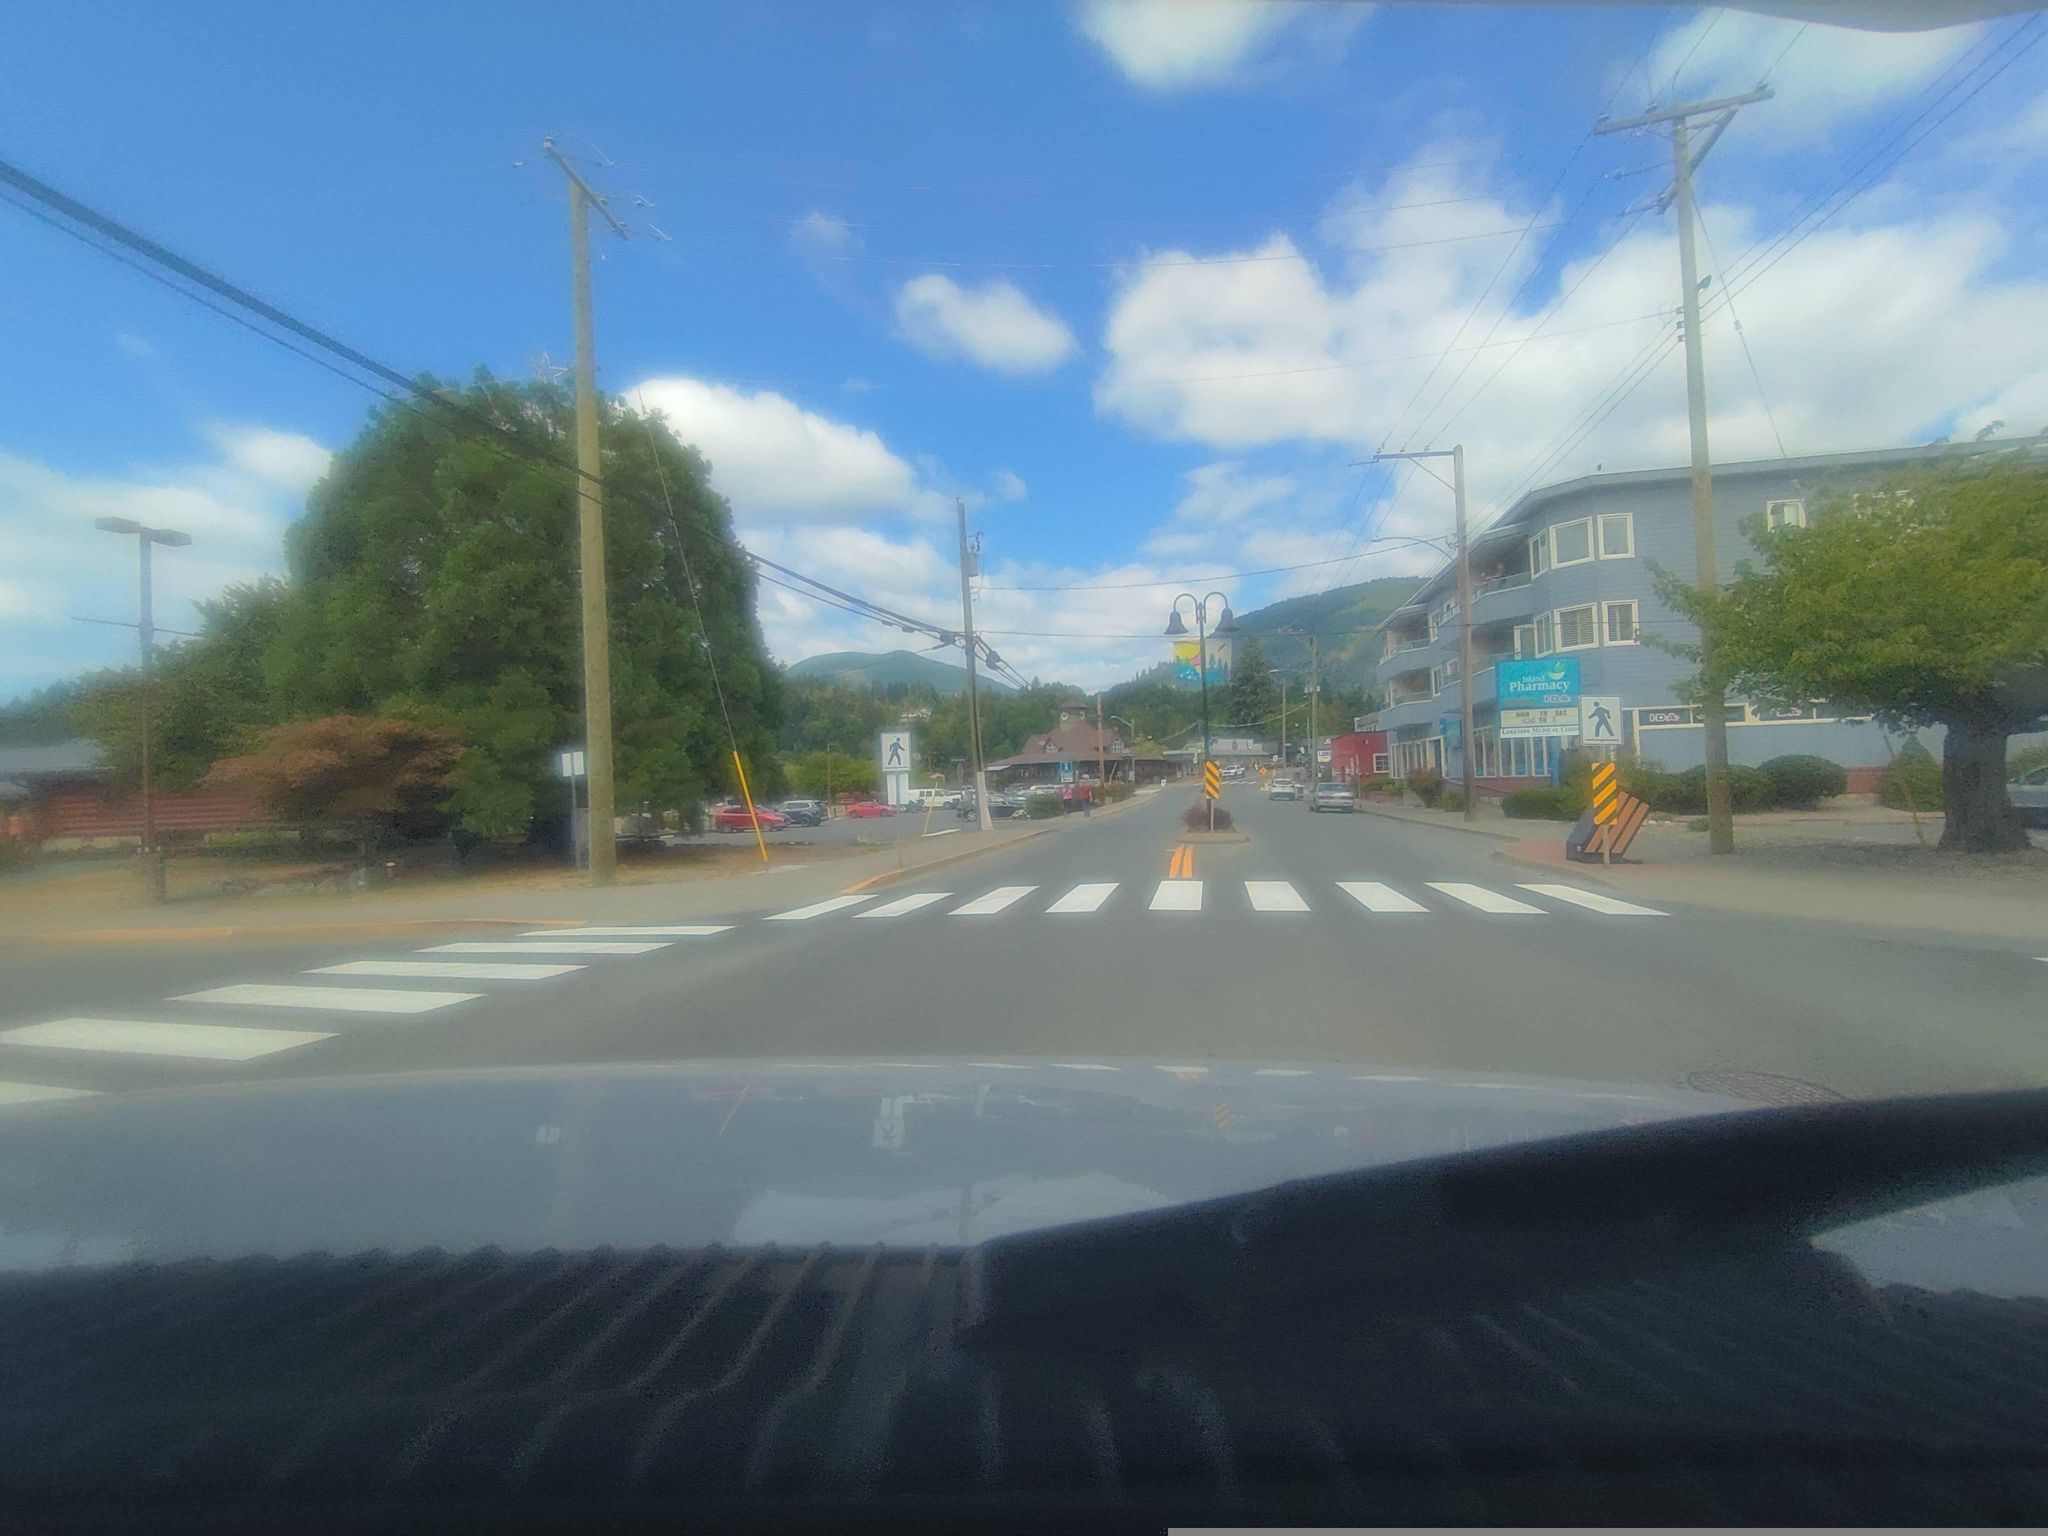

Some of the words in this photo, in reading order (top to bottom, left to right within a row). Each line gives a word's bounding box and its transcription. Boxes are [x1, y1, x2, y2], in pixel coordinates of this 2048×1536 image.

[1509, 681, 1570, 693] Pharmacy
[1554, 709, 1567, 717] SAT
[1648, 713, 1680, 722] IDA
